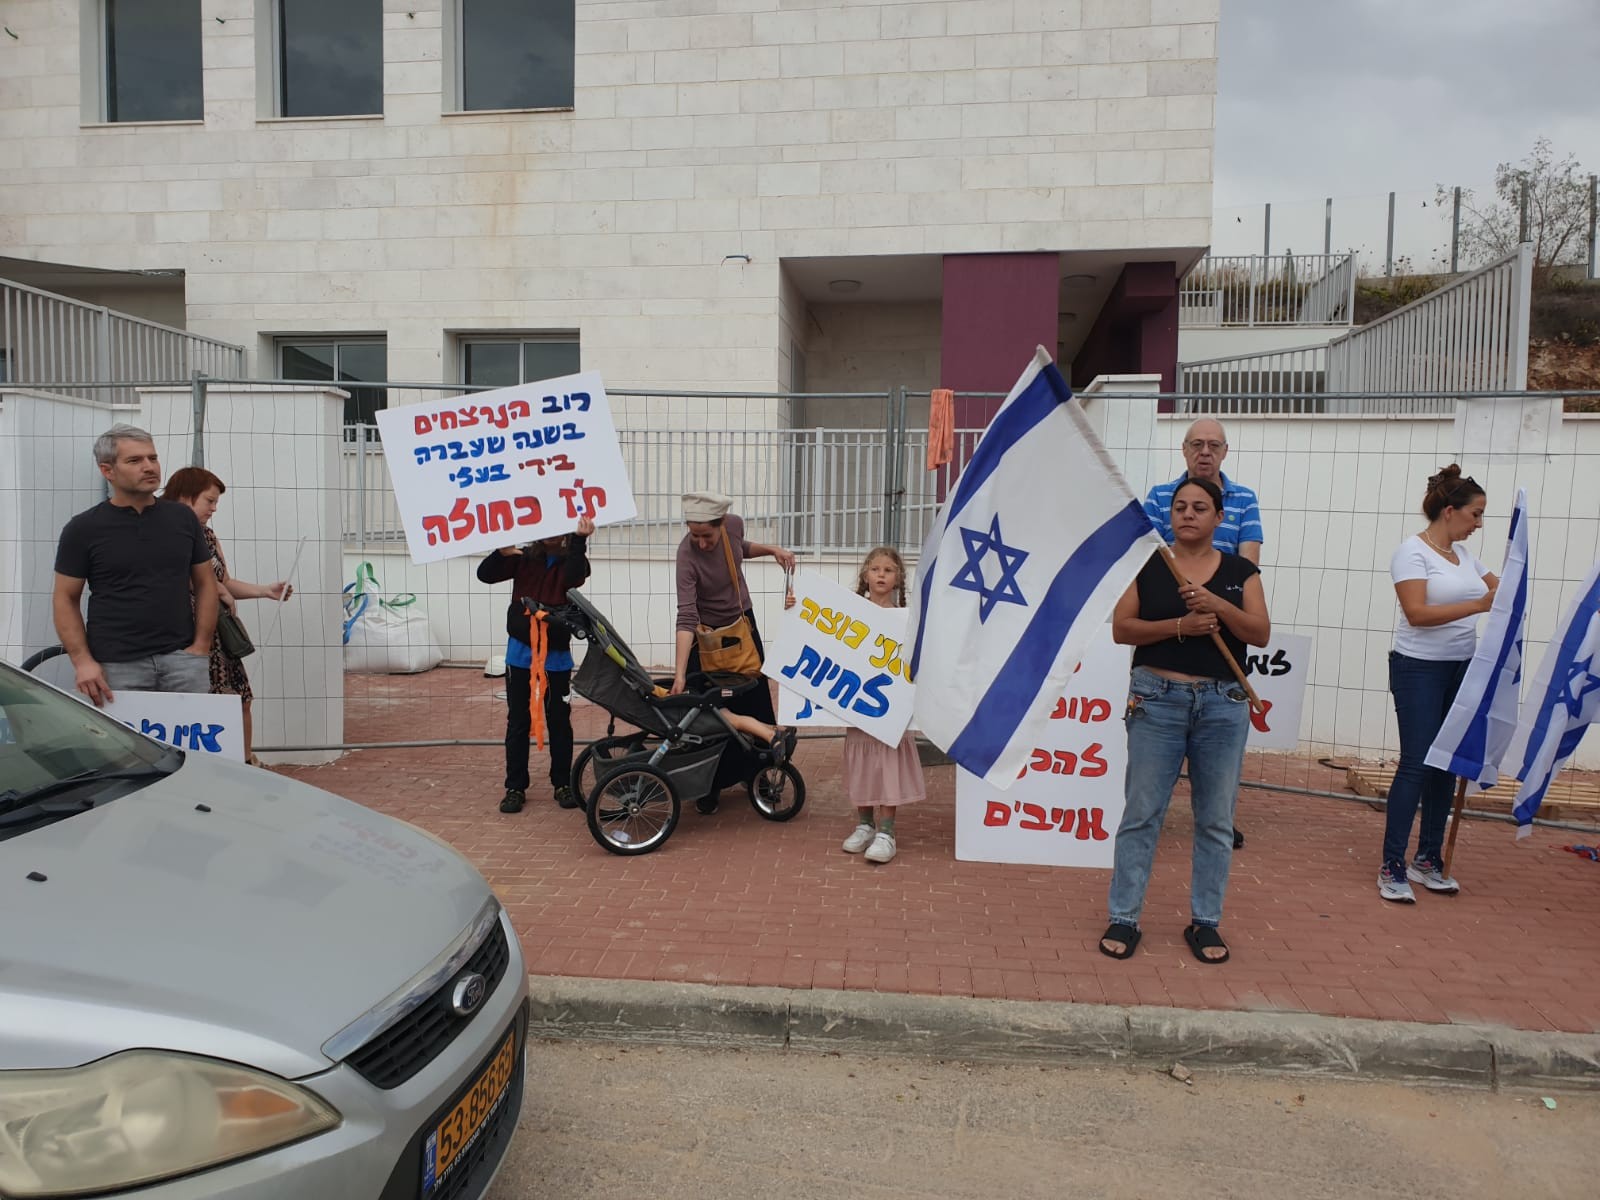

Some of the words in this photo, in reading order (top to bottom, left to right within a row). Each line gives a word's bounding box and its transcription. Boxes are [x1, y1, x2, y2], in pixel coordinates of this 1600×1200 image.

[415, 400, 530, 435] הנרצחים
[542, 392, 591, 413] רוב
[414, 435, 505, 465] שעברה
[512, 422, 585, 449] בשנה
[449, 464, 511, 488] בעלי
[518, 454, 575, 476] בידי
[422, 496, 543, 545] כחולה
[800, 597, 870, 649] רוצה
[781, 644, 893, 718] לחיות
[983, 800, 1110, 841] אויבים
